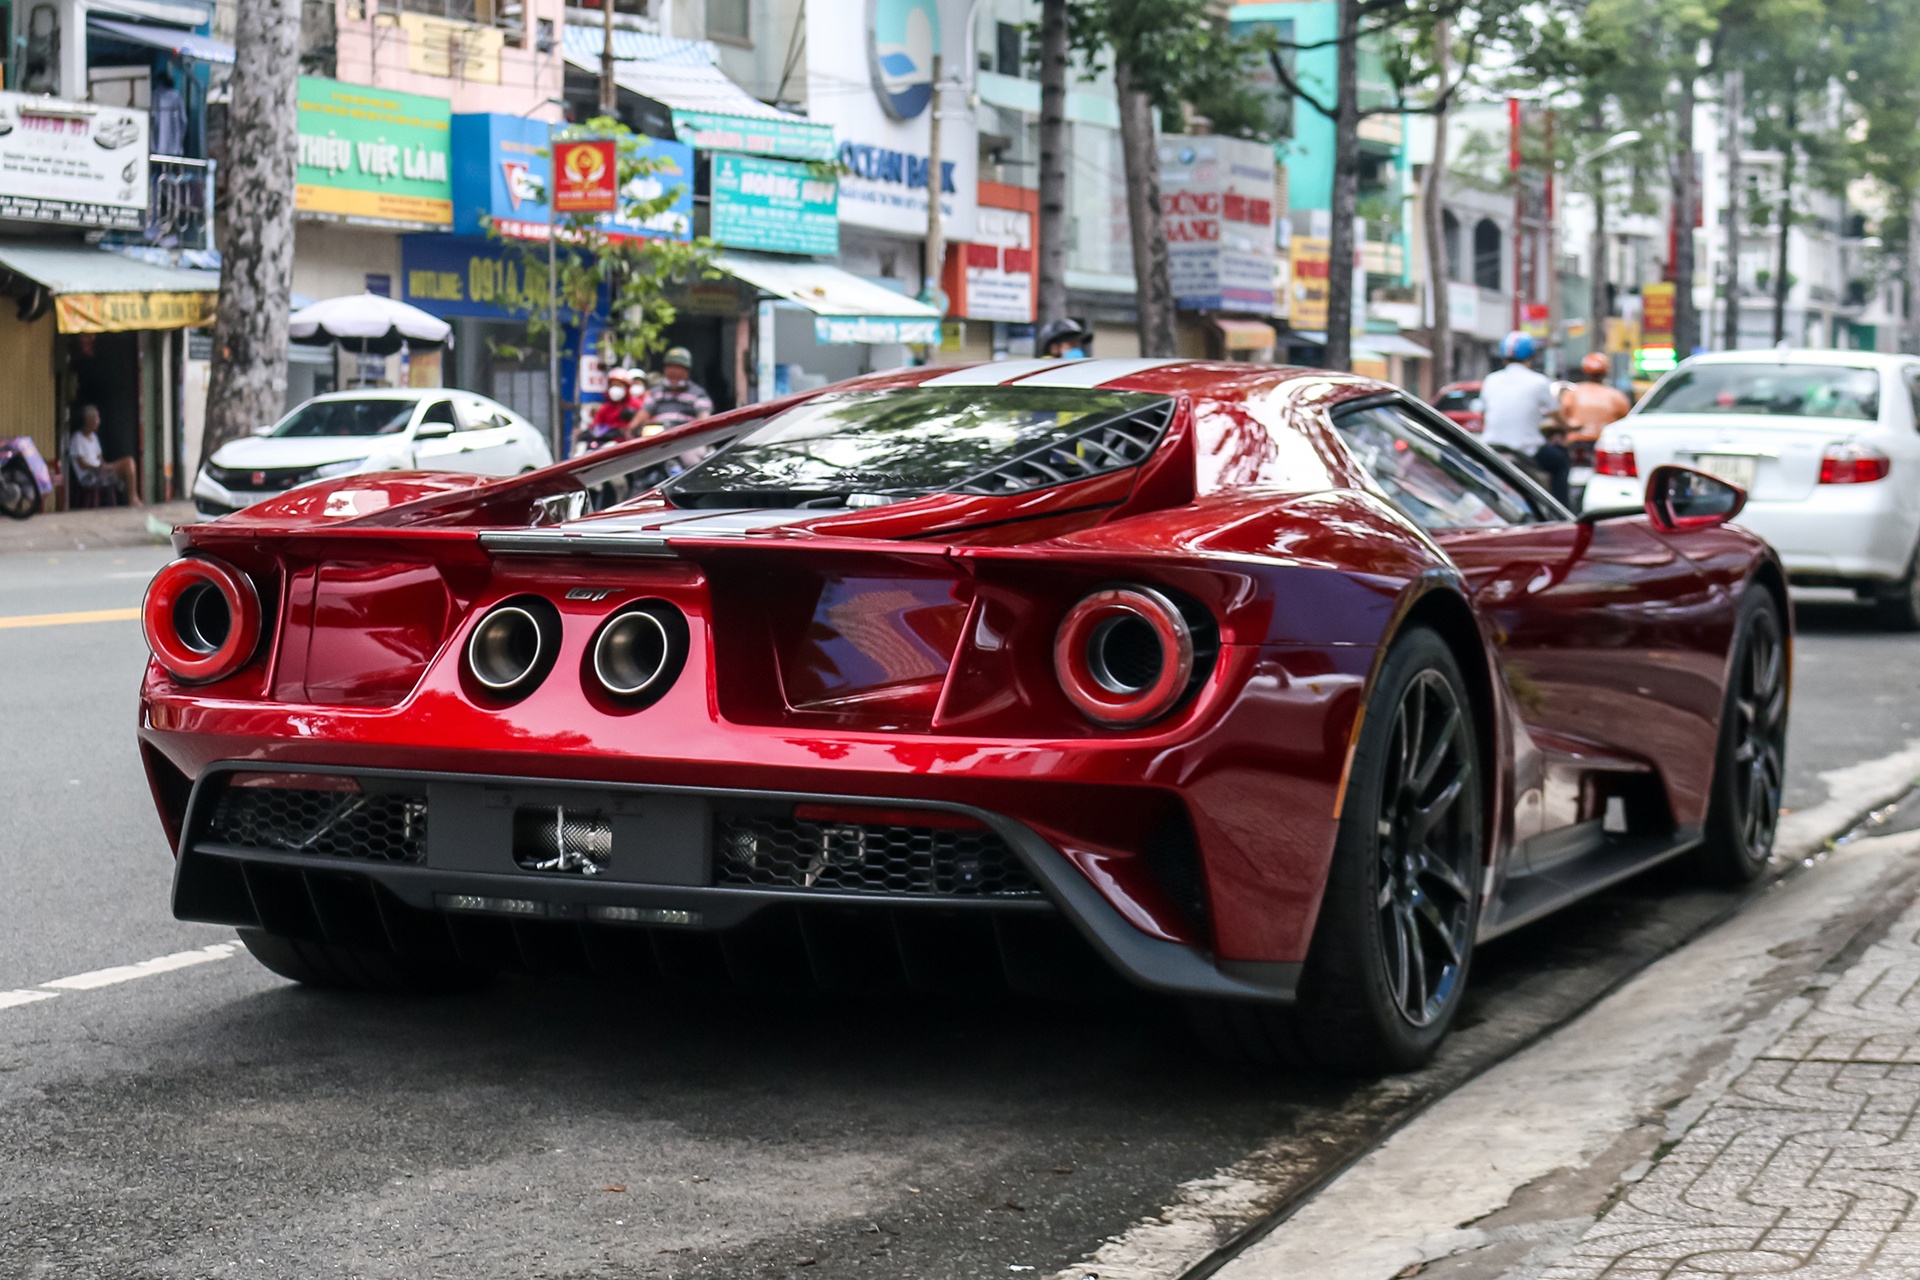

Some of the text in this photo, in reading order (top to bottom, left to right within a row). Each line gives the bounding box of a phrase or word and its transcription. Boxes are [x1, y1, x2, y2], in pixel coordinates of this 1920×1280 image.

[357, 136, 399, 182] VIỆC
[838, 140, 956, 194] OCEAN BAK
[565, 586, 625, 602] GT
